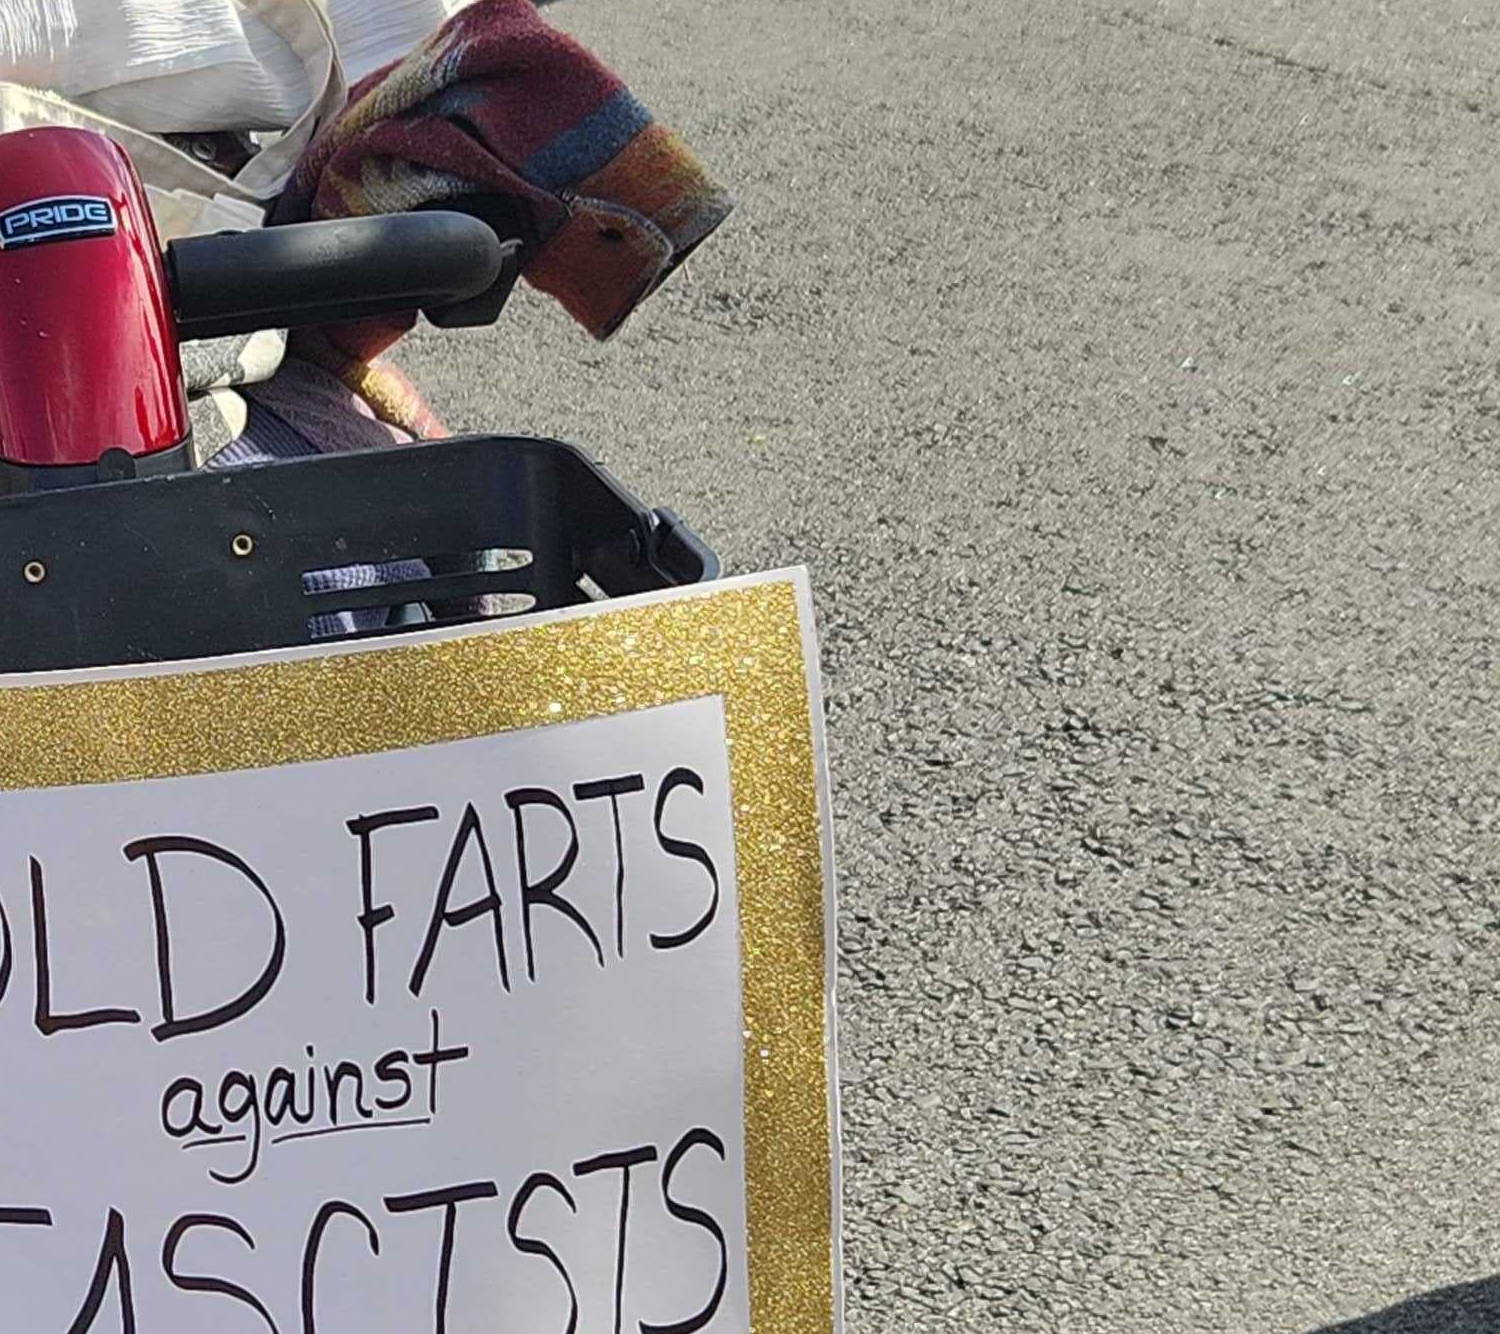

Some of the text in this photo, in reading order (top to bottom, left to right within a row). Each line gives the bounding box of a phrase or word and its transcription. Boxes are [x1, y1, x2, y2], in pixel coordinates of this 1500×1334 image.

[4, 203, 108, 235] PRIDE
[345, 767, 719, 1005] FARTS
[161, 1009, 469, 1184] against
